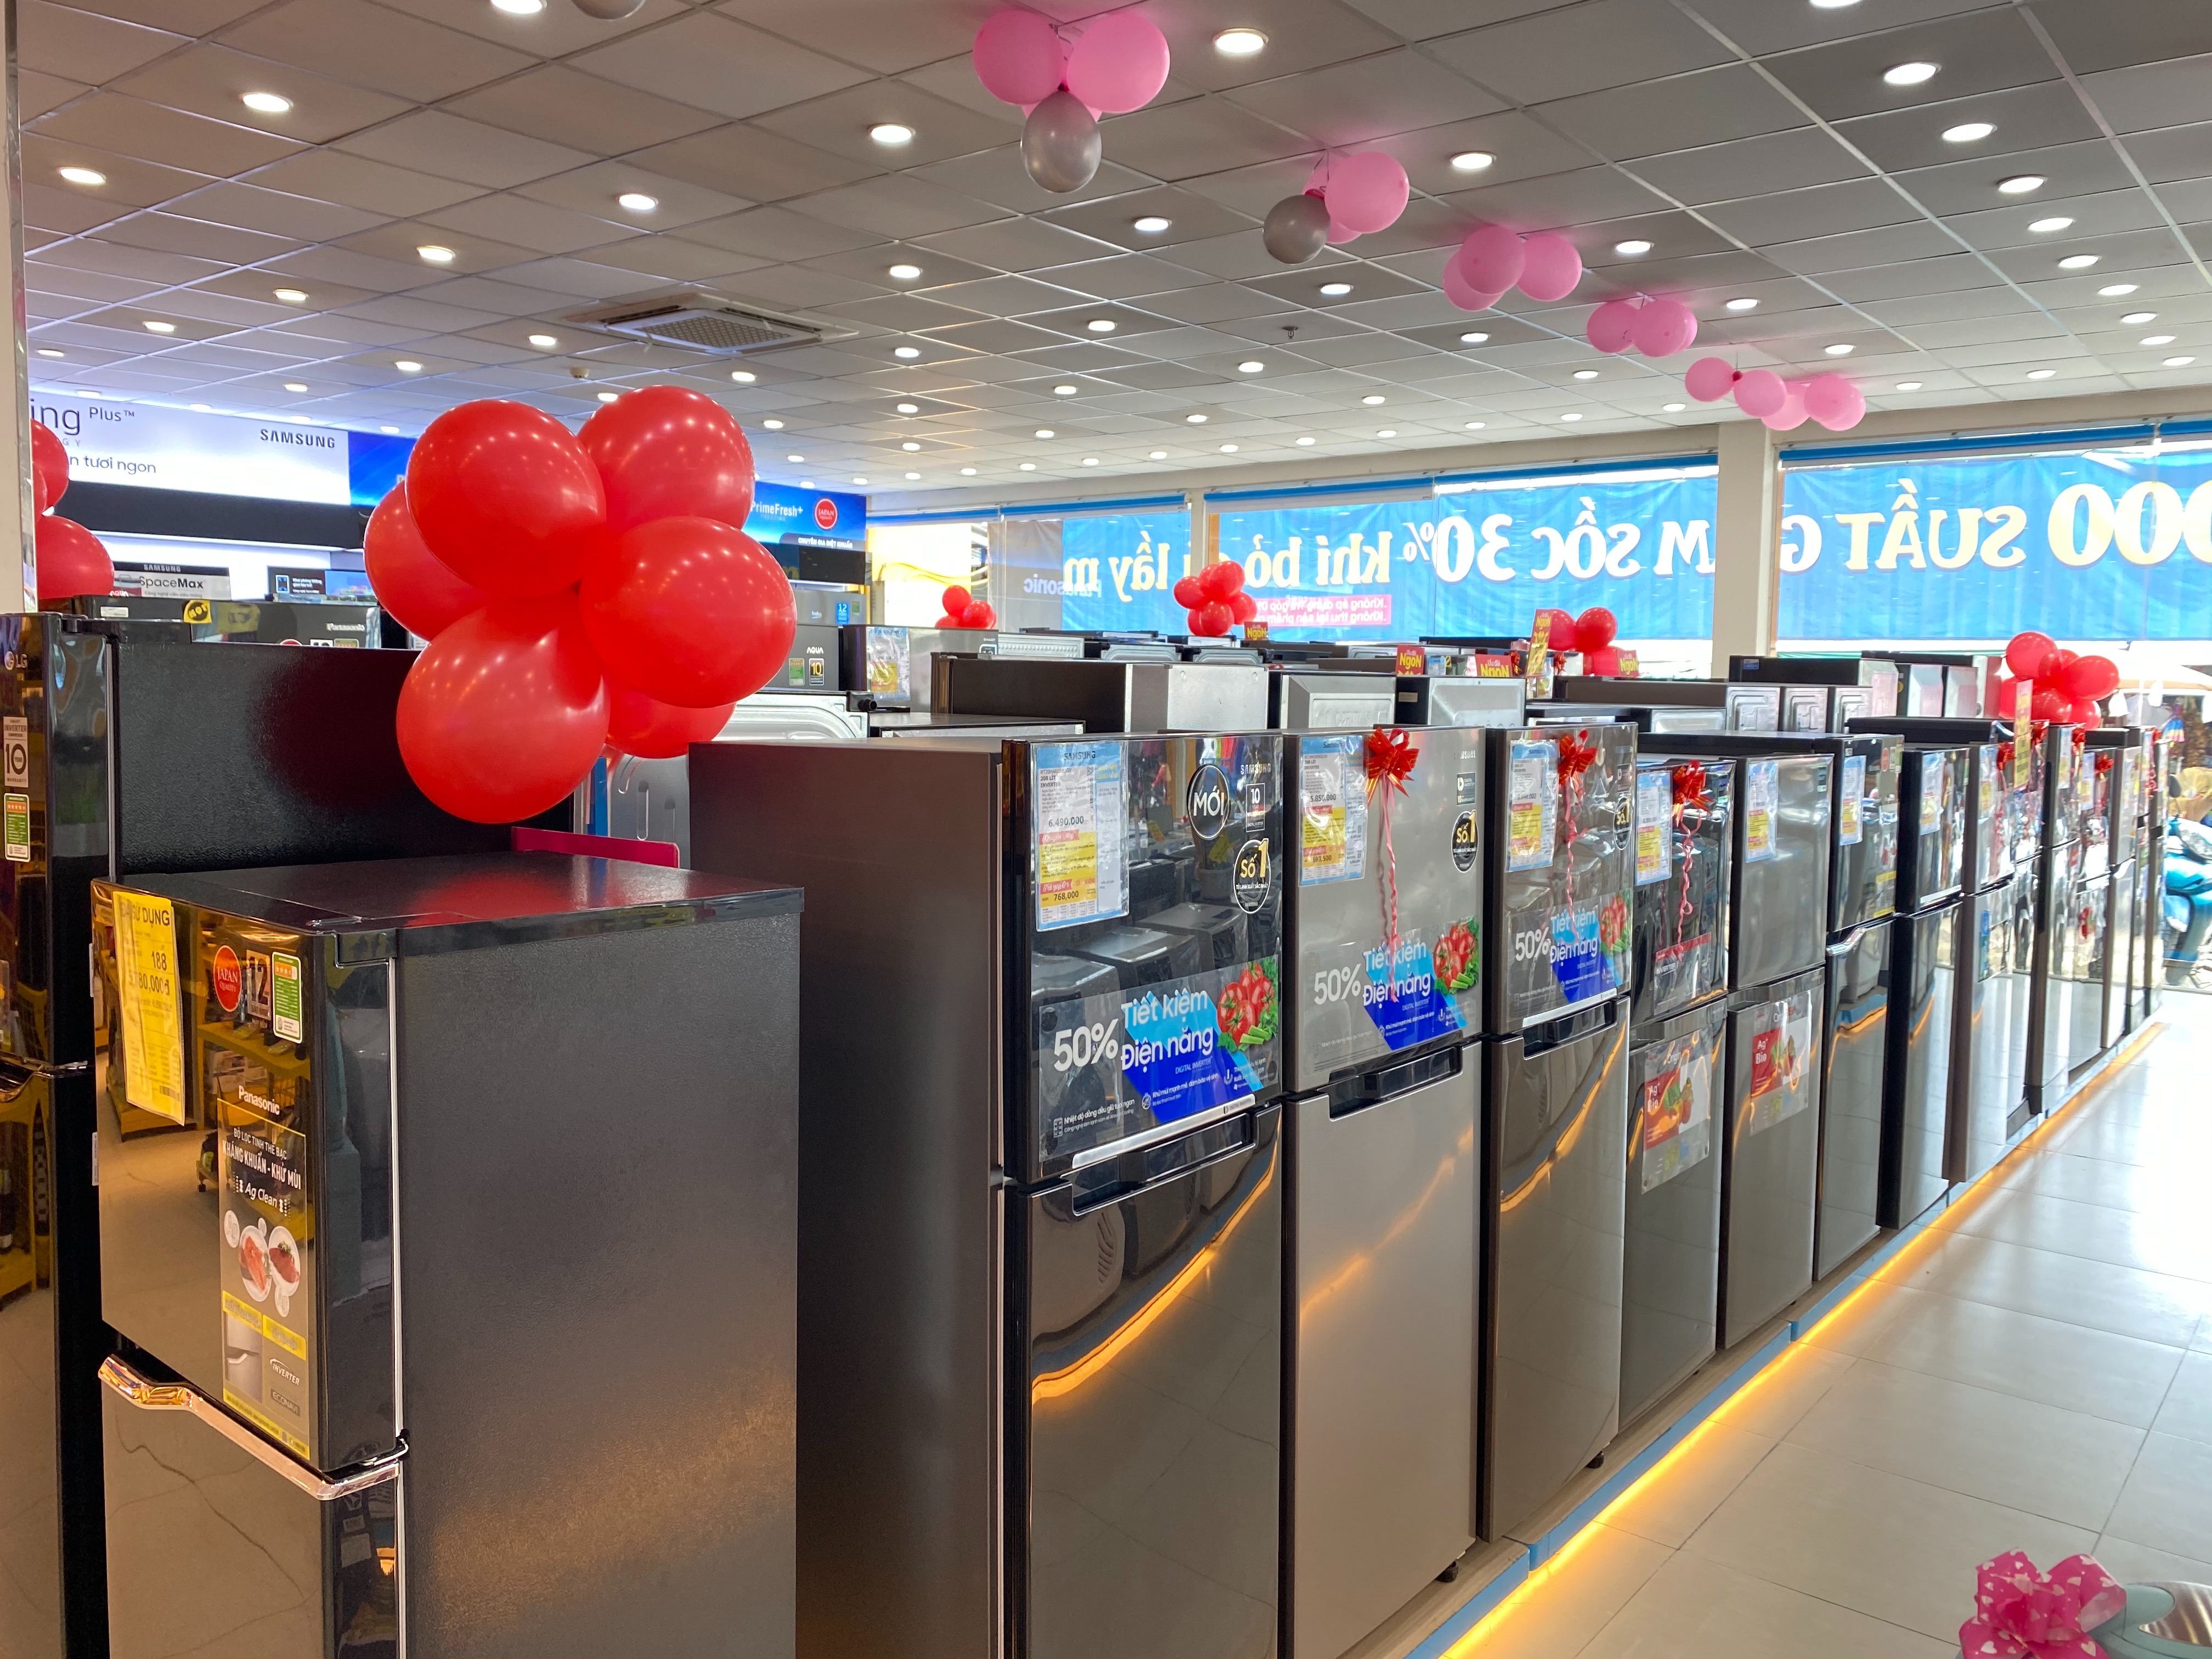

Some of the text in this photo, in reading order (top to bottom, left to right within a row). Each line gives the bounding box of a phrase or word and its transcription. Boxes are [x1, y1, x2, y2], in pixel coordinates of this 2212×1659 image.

[260, 428, 335, 448] SAMSUNG
[83, 455, 113, 469] tươi
[117, 460, 156, 475] ngon
[143, 564, 181, 572] SAMSUNG
[838, 603, 847, 612] 12
[811, 662, 822, 675] 10
[5, 743, 26, 775] 10
[1064, 751, 1096, 760] SAMSUNG
[1240, 763, 1271, 775] SAMSUNG
[1193, 785, 1224, 816] MỚI
[1250, 788, 1260, 804] 10
[1048, 816, 1084, 827] 6.490.000
[1258, 840, 1267, 878] 1
[1053, 890, 1079, 901] 768,000
[142, 907, 170, 928] DỤNG
[1550, 909, 1570, 934] Tiết
[1515, 927, 1549, 961] 50%
[1549, 941, 1572, 967] Điện
[1573, 936, 1598, 957] năng
[151, 951, 167, 971] 188
[217, 966, 238, 983] JAPAN
[1314, 963, 1362, 1005] 50%
[1397, 971, 1431, 997] năng
[1121, 988, 1207, 1029] Tiết kiệm
[1054, 1018, 1119, 1072] 50%
[1120, 1025, 1214, 1073] Điện năng
[1175, 1063, 1192, 1074] DIGITAL
[1756, 1051, 1767, 1064] Bio
[238, 1085, 280, 1115] Panasonic
[1647, 1098, 1659, 1112] Bio
[233, 1126, 241, 1141] BỘ
[241, 1131, 251, 1145] LỌC
[251, 1135, 264, 1150] TINH
[275, 1147, 287, 1161] BẠC
[222, 1139, 244, 1164] KHÁNG
[271, 1161, 287, 1183] KHỬ
[287, 1168, 301, 1190] MÙI
[245, 1182, 278, 1209] Ag Clean
[272, 1363, 300, 1386] INVERTER
[272, 1391, 299, 1414] ECONAVI
